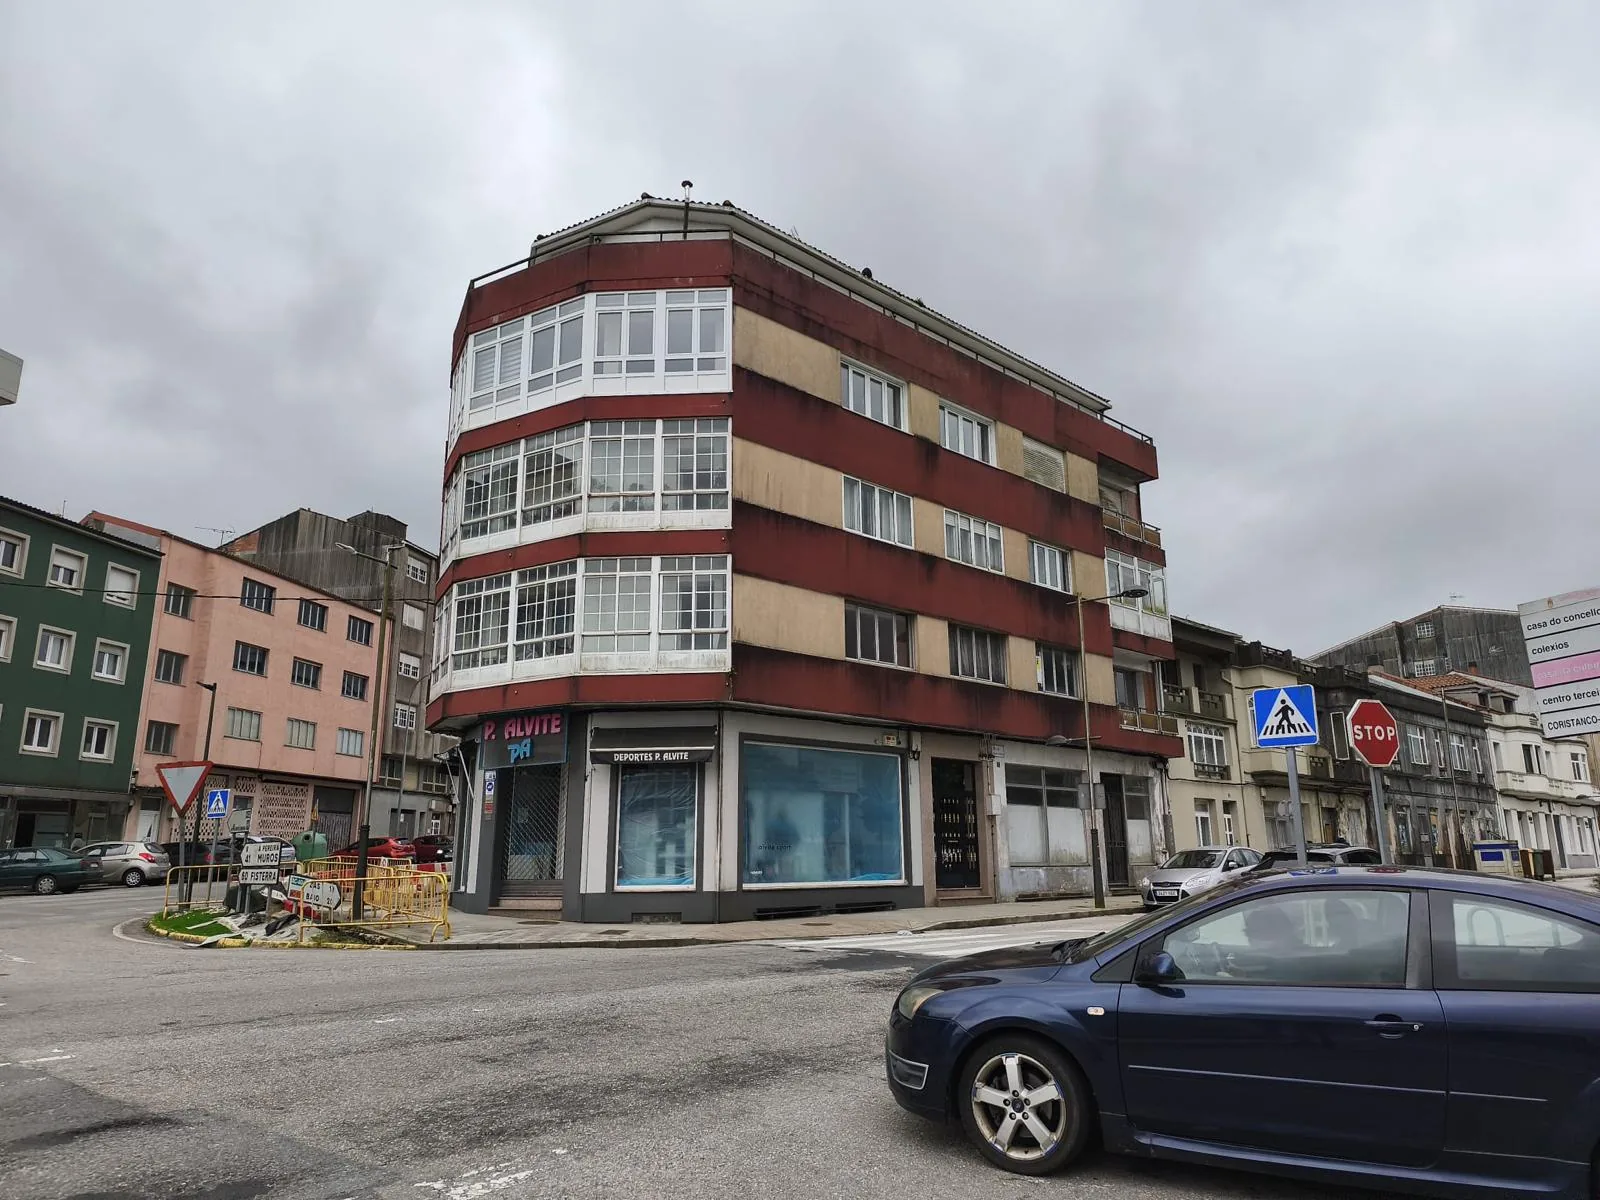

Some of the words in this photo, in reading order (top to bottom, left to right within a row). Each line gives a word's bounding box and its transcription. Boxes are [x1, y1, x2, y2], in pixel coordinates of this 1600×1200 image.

[1526, 620, 1548, 631] casa
[1550, 617, 1562, 626] do
[1532, 641, 1570, 655] colexios
[1542, 694, 1572, 705] centro
[484, 720, 496, 740] P.
[504, 712, 561, 740] ALVITE
[1354, 724, 1395, 740] STOP
[614, 752, 653, 762] DEPORTES
[654, 752, 661, 761] P.
[663, 752, 689, 761] ALVITE
[257, 853, 279, 863] MUROS
[250, 871, 276, 881] FISTERRA
